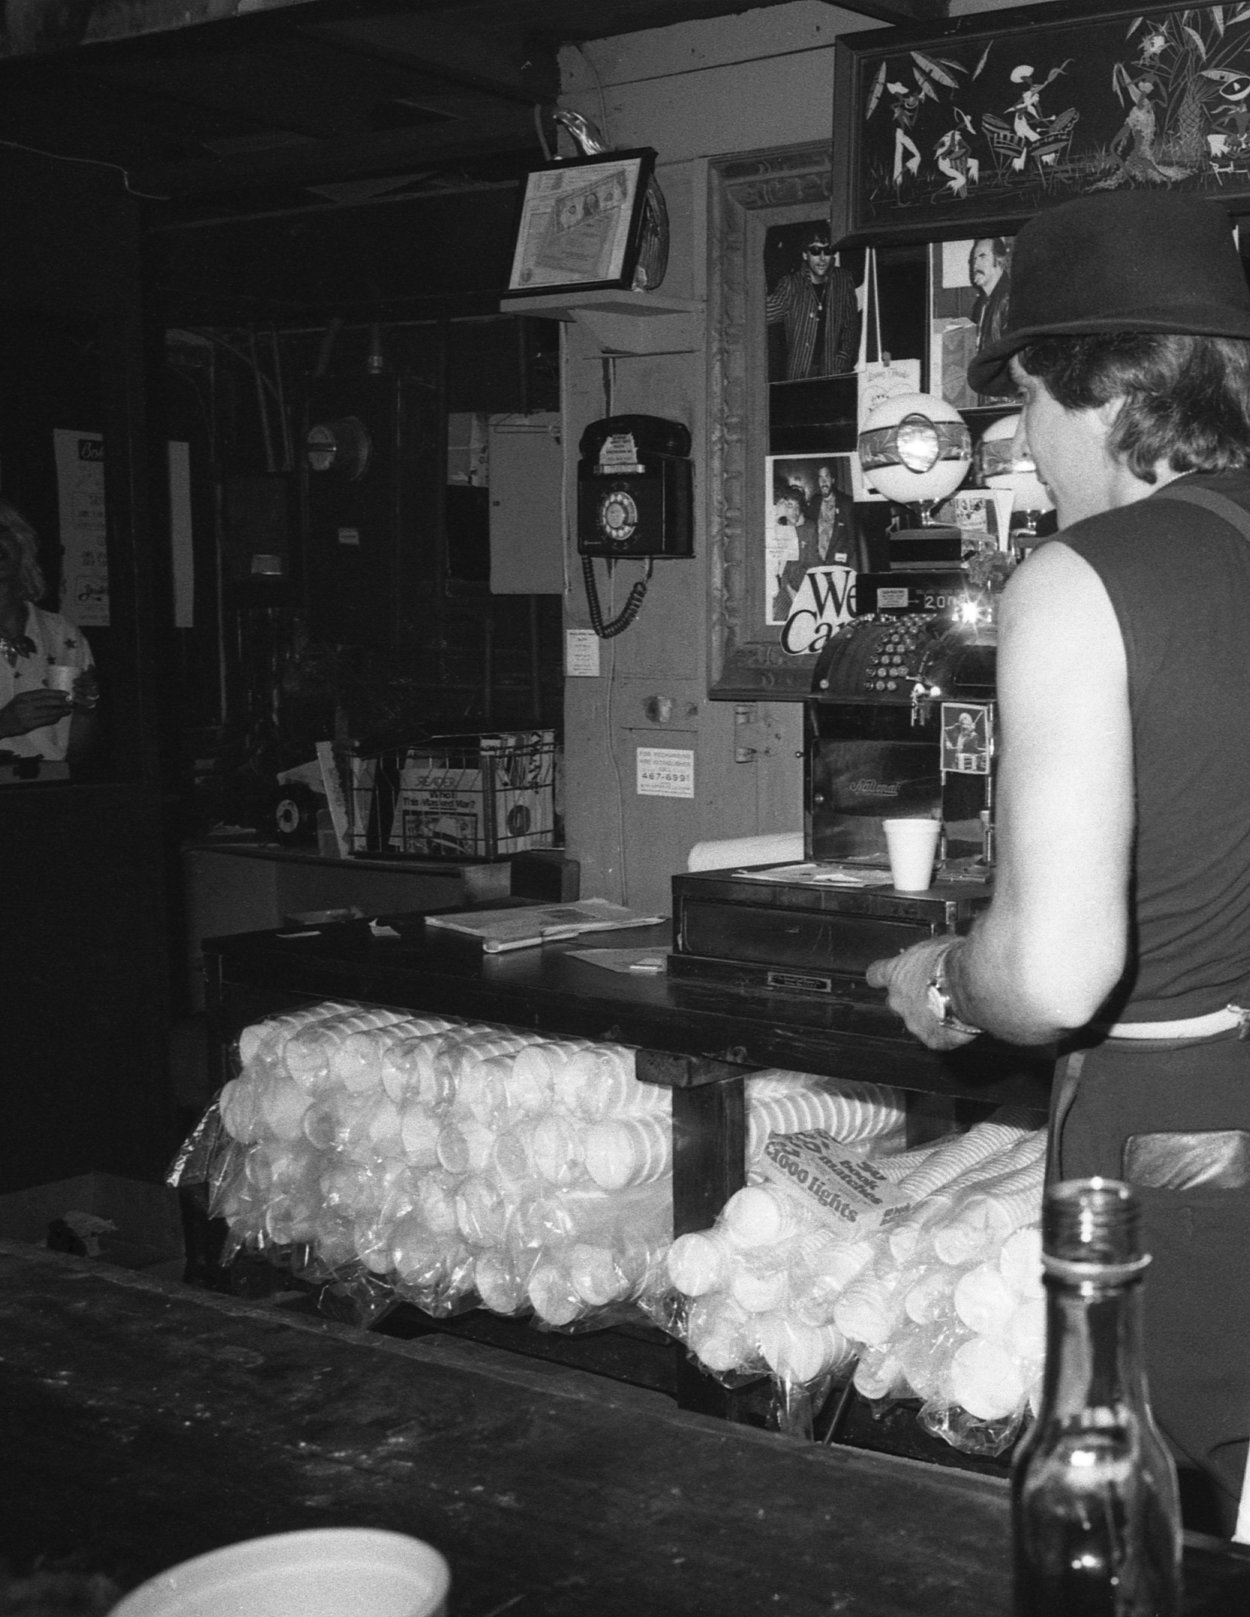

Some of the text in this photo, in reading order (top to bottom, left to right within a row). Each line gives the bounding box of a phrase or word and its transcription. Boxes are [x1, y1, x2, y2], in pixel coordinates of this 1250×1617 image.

[807, 570, 857, 619] We
[848, 777, 901, 796] National
[807, 1176, 859, 1223] lights
